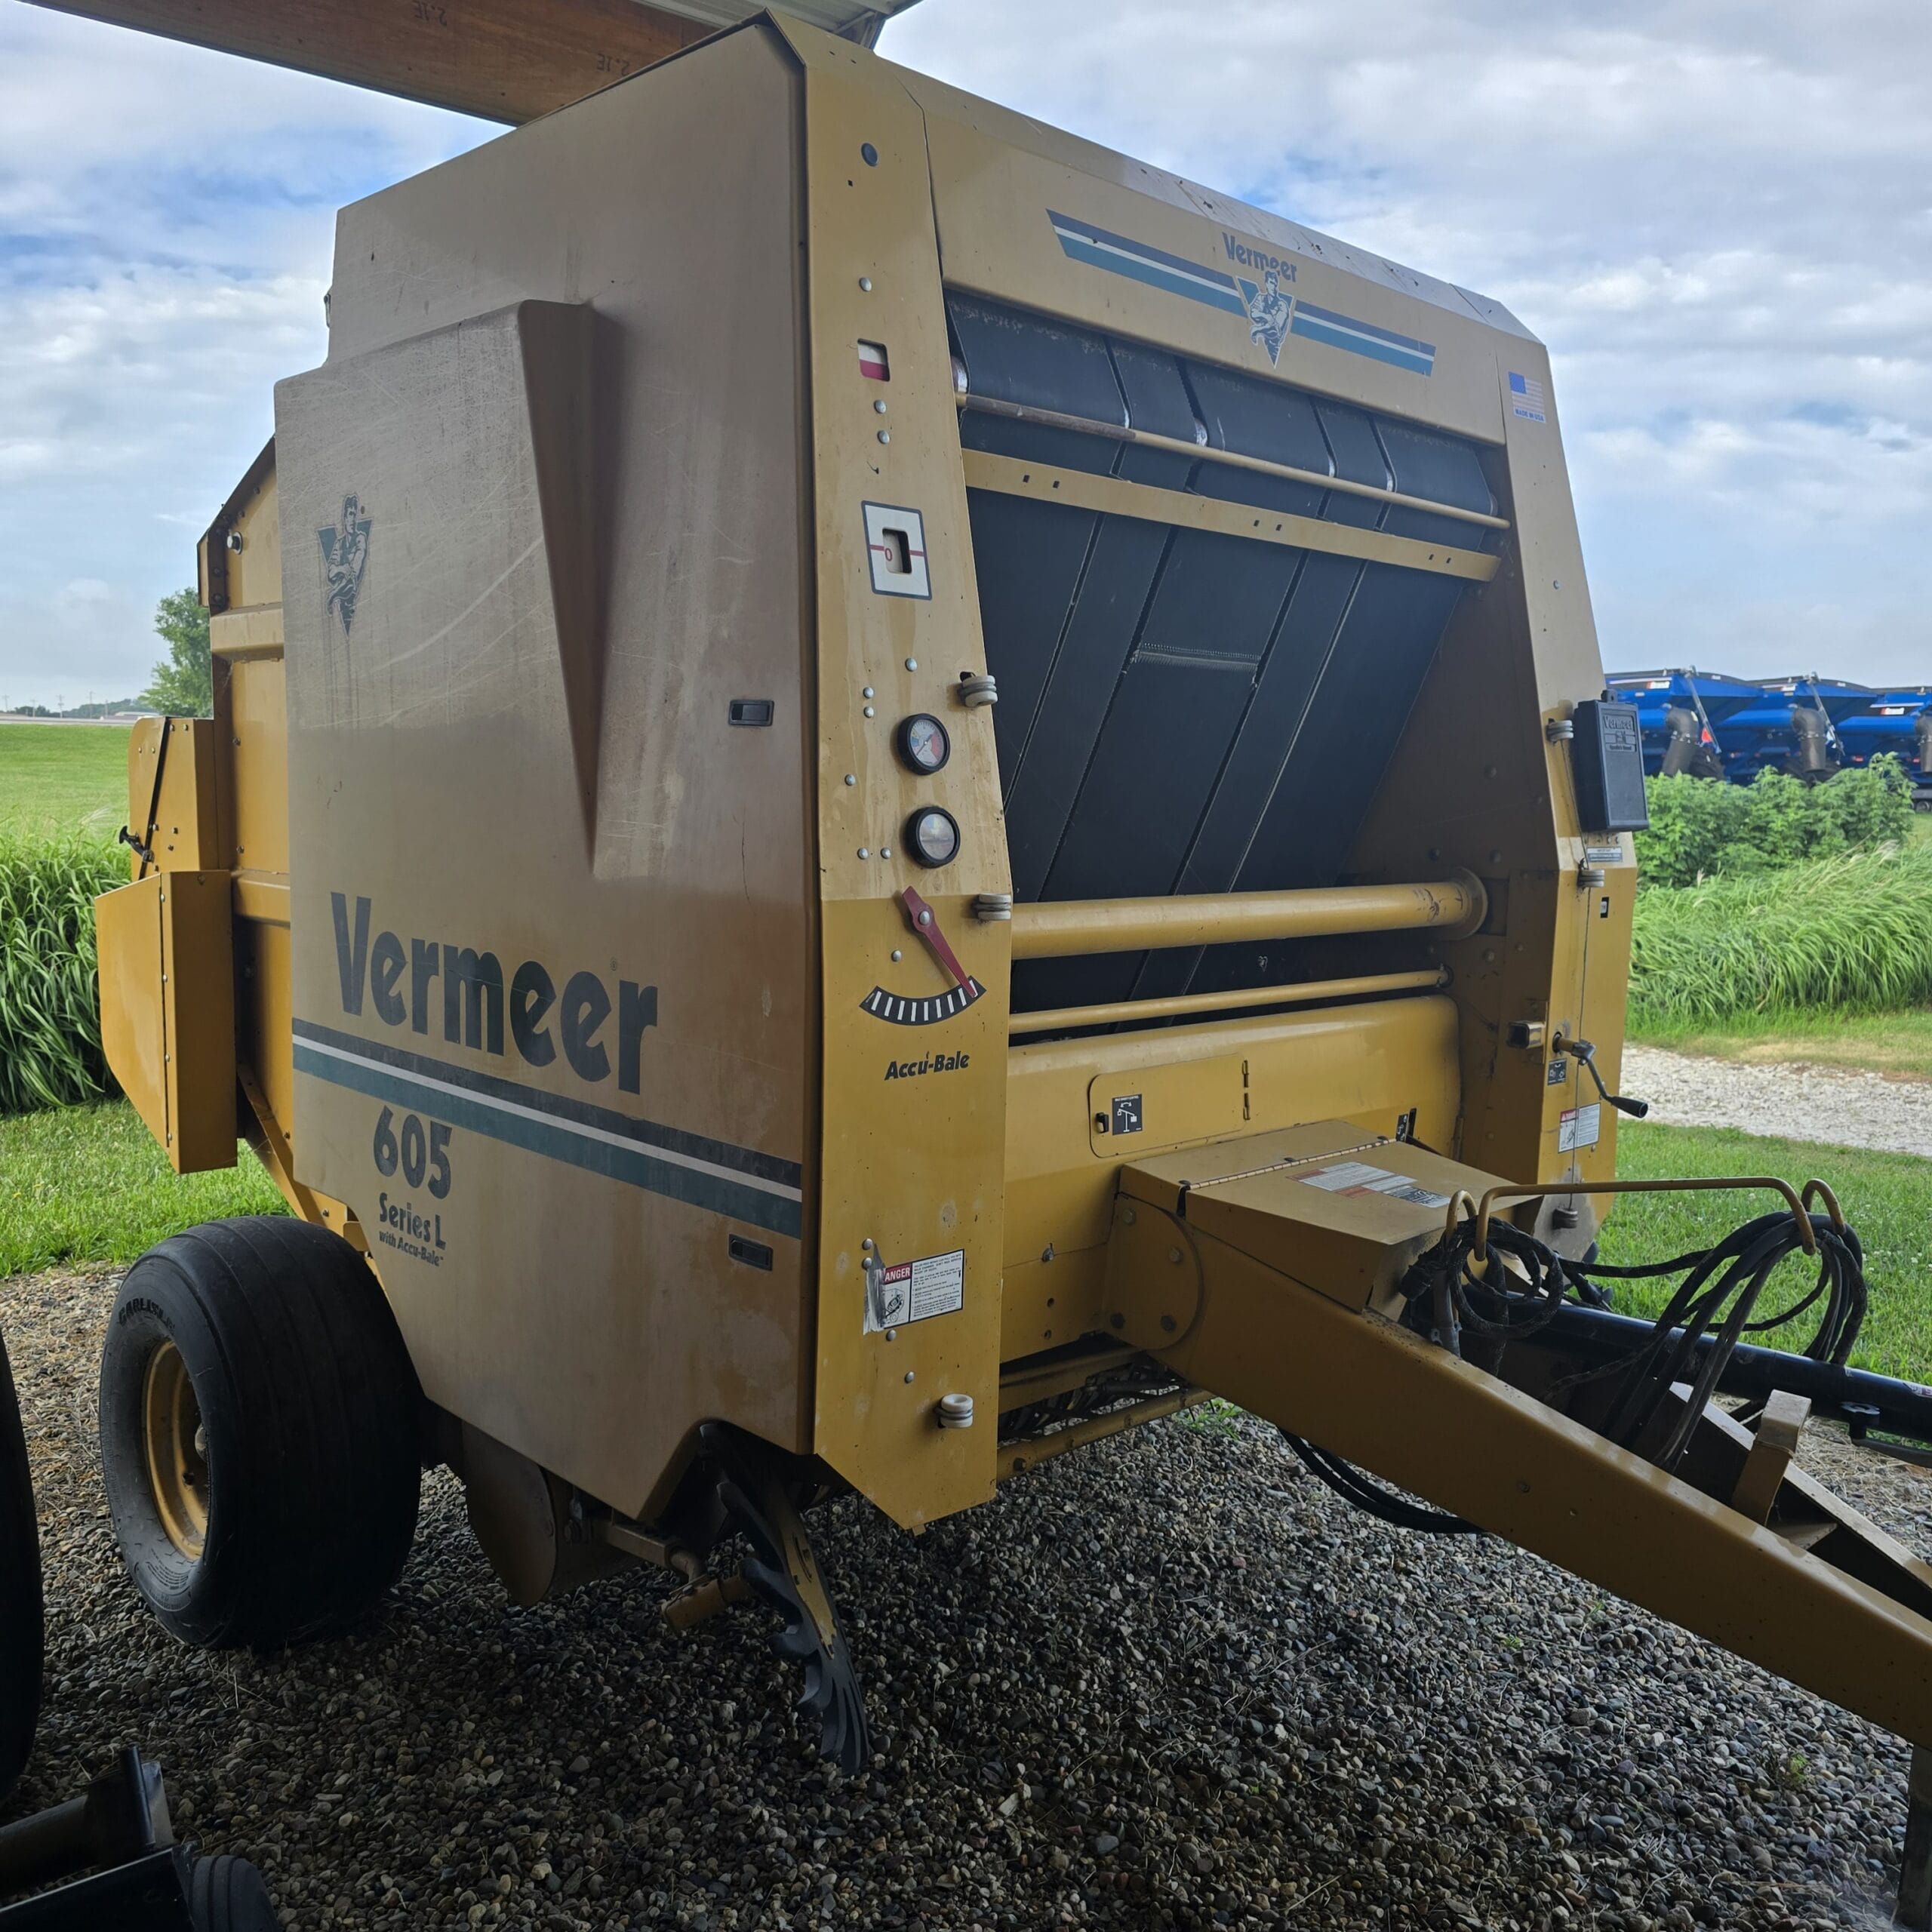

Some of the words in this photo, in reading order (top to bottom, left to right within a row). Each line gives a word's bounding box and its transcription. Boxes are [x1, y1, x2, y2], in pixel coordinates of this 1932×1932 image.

[1222, 231, 1297, 283] Vermeer
[331, 891, 658, 1095] Vermeer
[884, 1050, 970, 1081] Accu-Bale
[374, 1105, 453, 1199] 605
[379, 1192, 431, 1243] Series
[435, 1214, 447, 1251] L
[379, 1230, 396, 1248] with
[884, 1267, 910, 1282] ANGER
